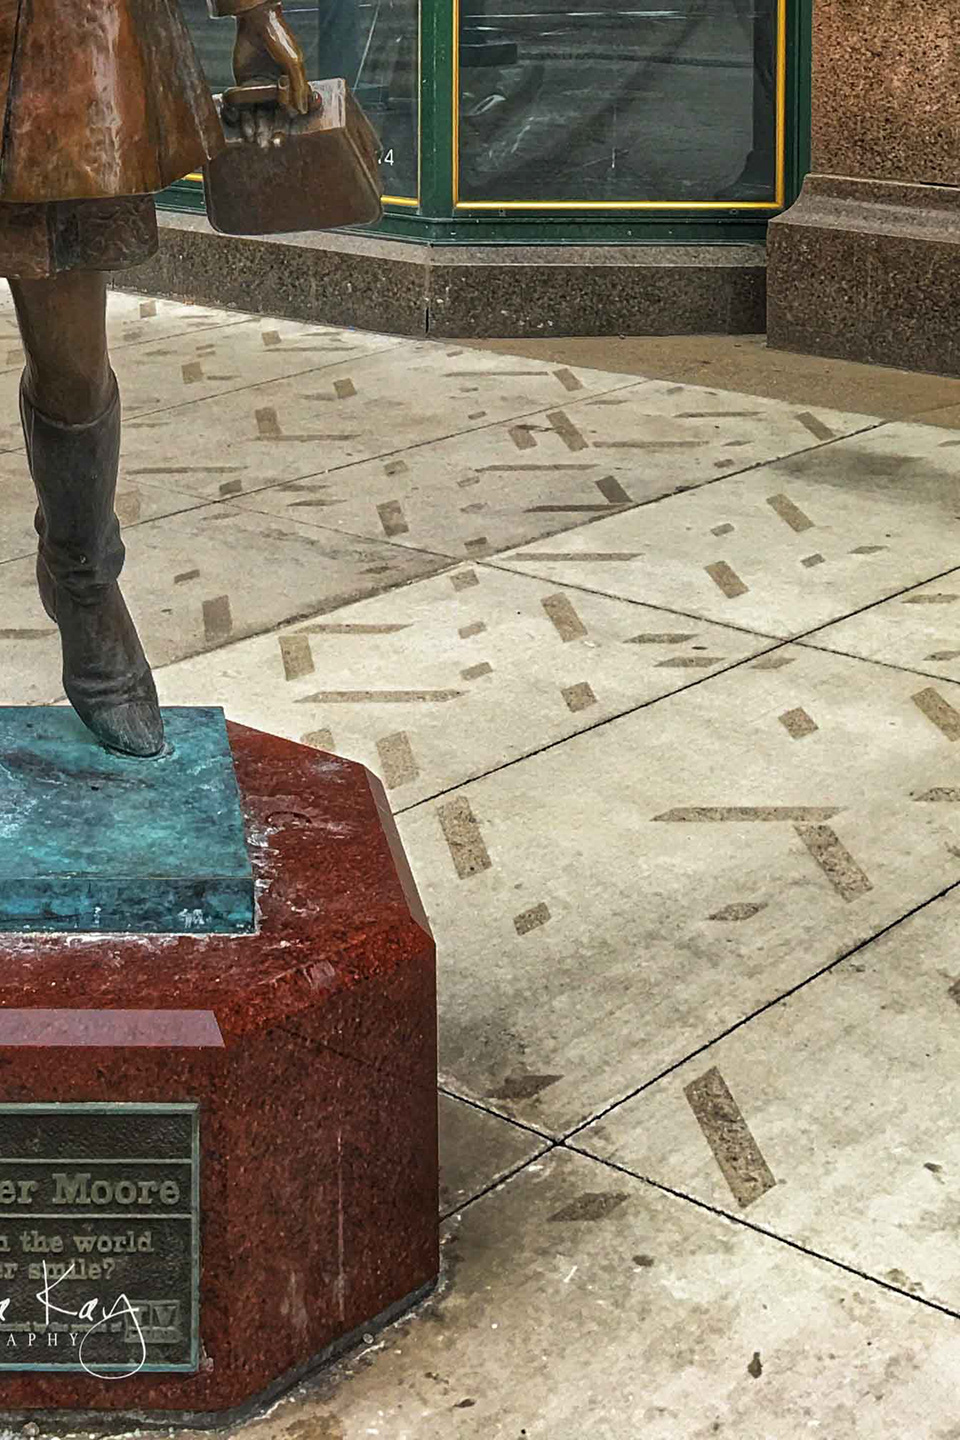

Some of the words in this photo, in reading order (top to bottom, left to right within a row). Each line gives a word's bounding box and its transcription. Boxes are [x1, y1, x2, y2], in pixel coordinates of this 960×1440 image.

[51, 1172, 181, 1206] Moore
[19, 1230, 64, 1253] the
[72, 1230, 155, 1253] world
[27, 1257, 117, 1280] smile?
